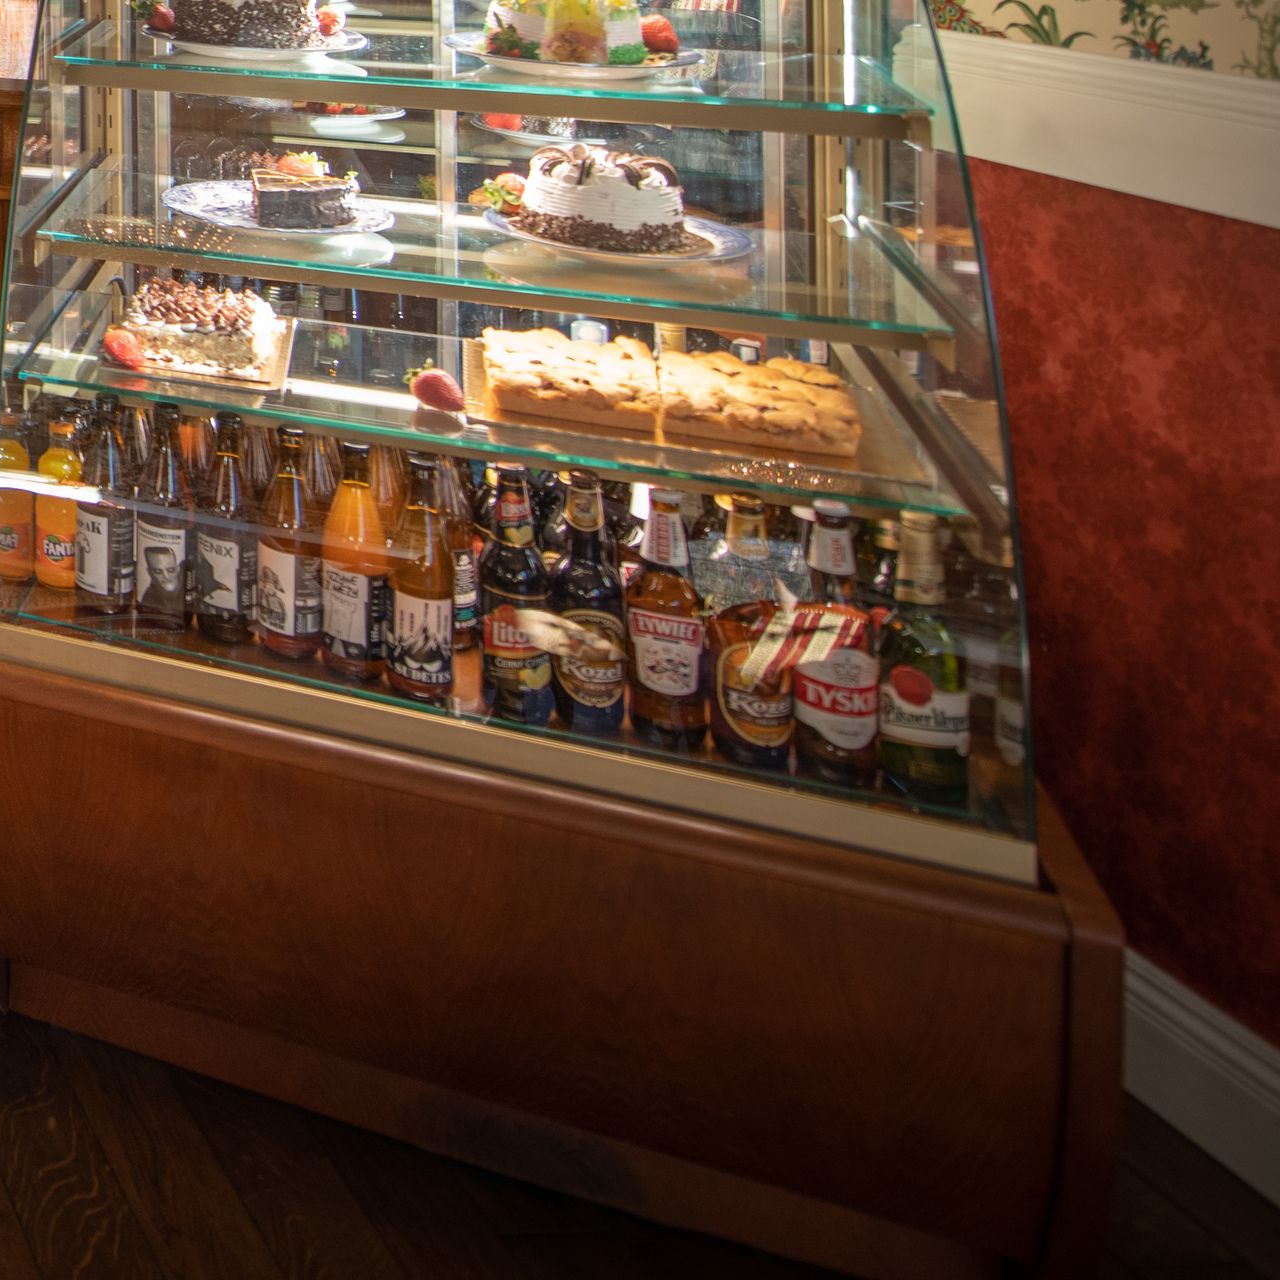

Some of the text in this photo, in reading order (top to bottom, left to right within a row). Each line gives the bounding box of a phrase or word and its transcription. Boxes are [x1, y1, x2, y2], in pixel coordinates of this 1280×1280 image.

[198, 539, 234, 558] FENIX
[493, 621, 531, 648] Lito
[727, 688, 792, 717] Koze
[801, 679, 877, 713] TYSKI
